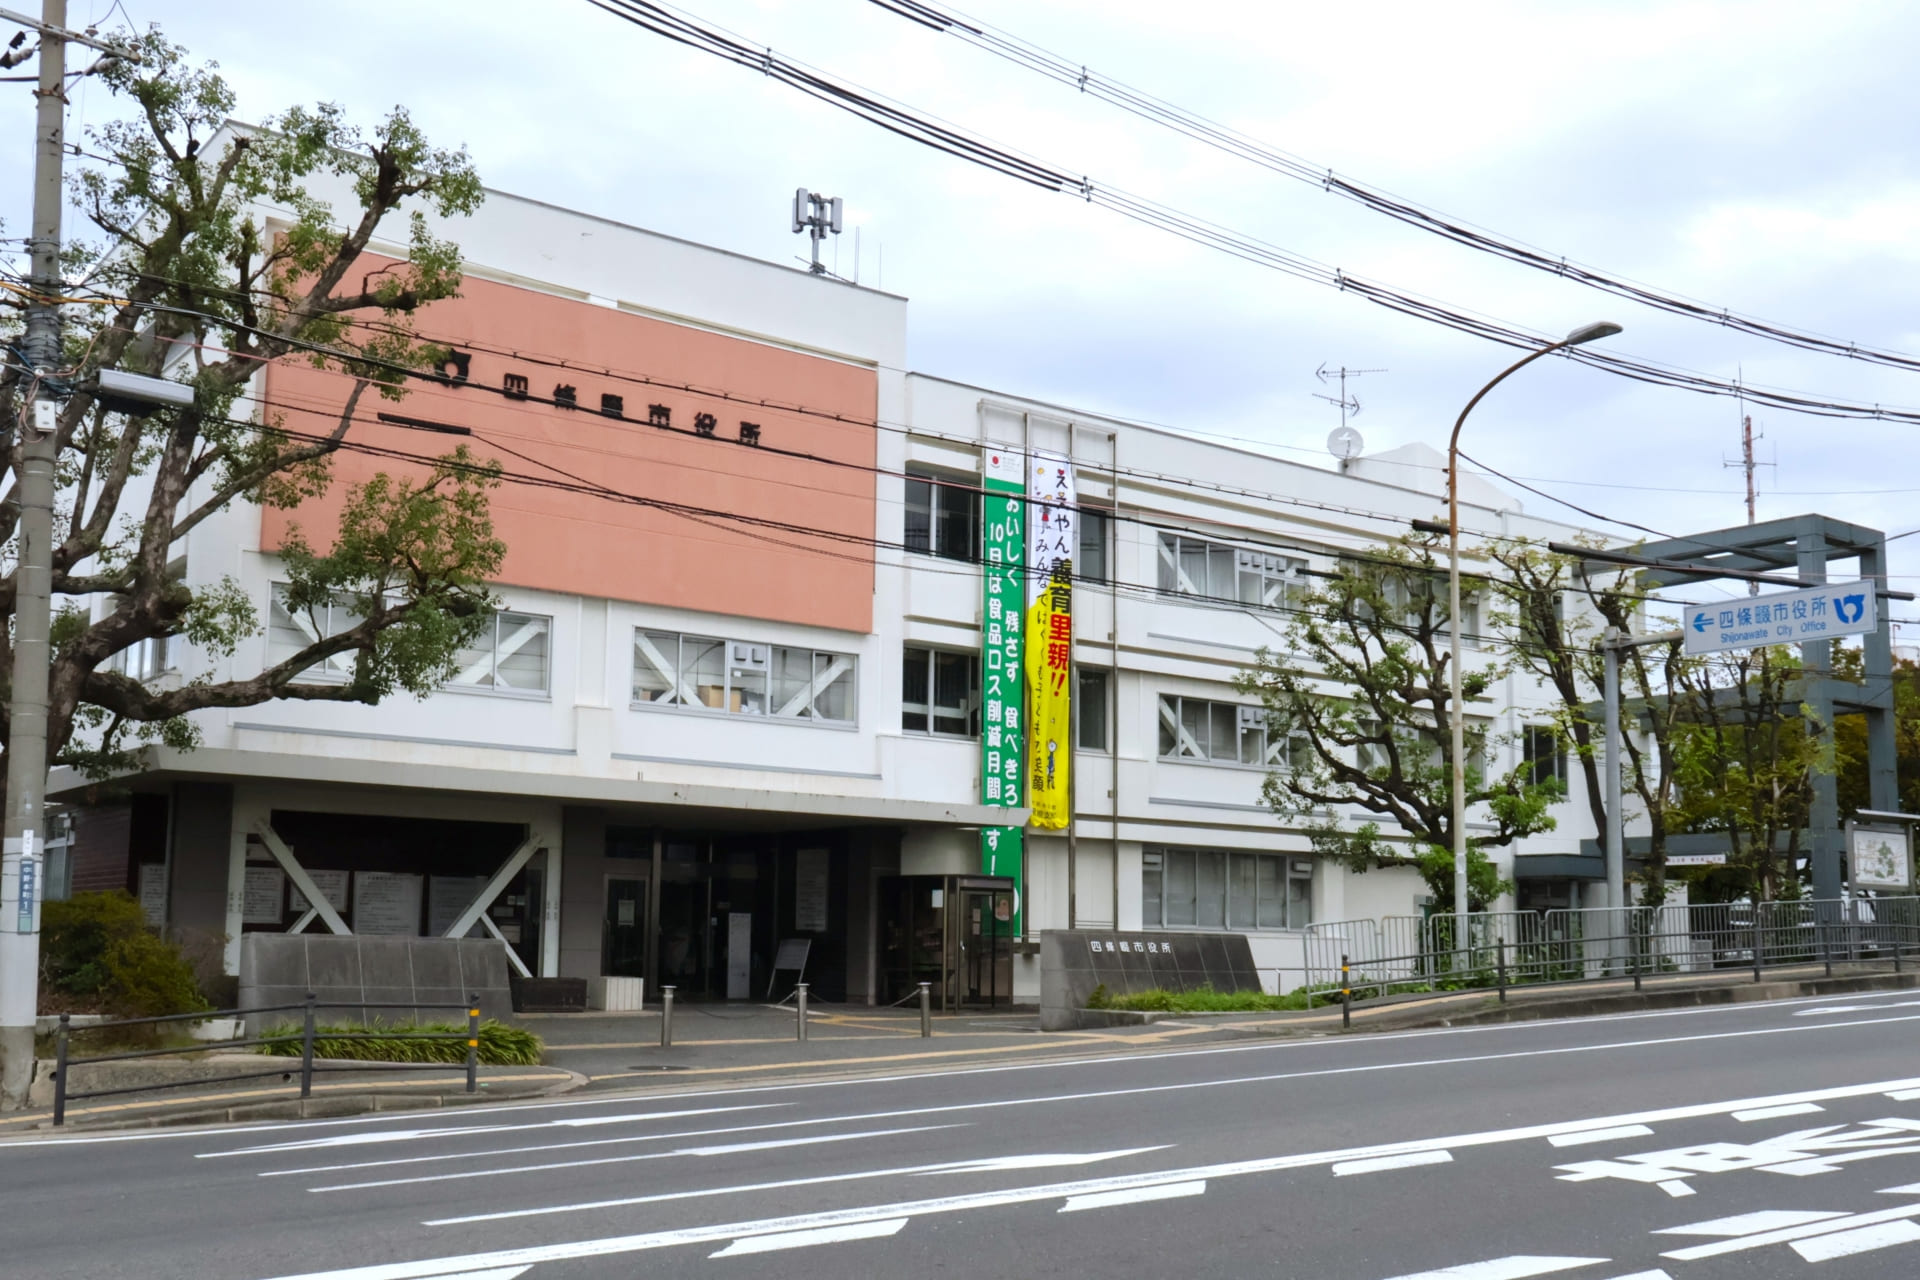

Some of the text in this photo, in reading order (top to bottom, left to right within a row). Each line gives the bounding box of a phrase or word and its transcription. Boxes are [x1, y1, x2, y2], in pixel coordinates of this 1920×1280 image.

[987, 523, 1004, 876] 10月は食品ロス削減月間す!
[1004, 498, 1020, 831] おいしく 残さず 食べきろ
[1719, 596, 1826, 629] 四條畷市役所
[1721, 621, 1826, 643] Shijonawate City Office
